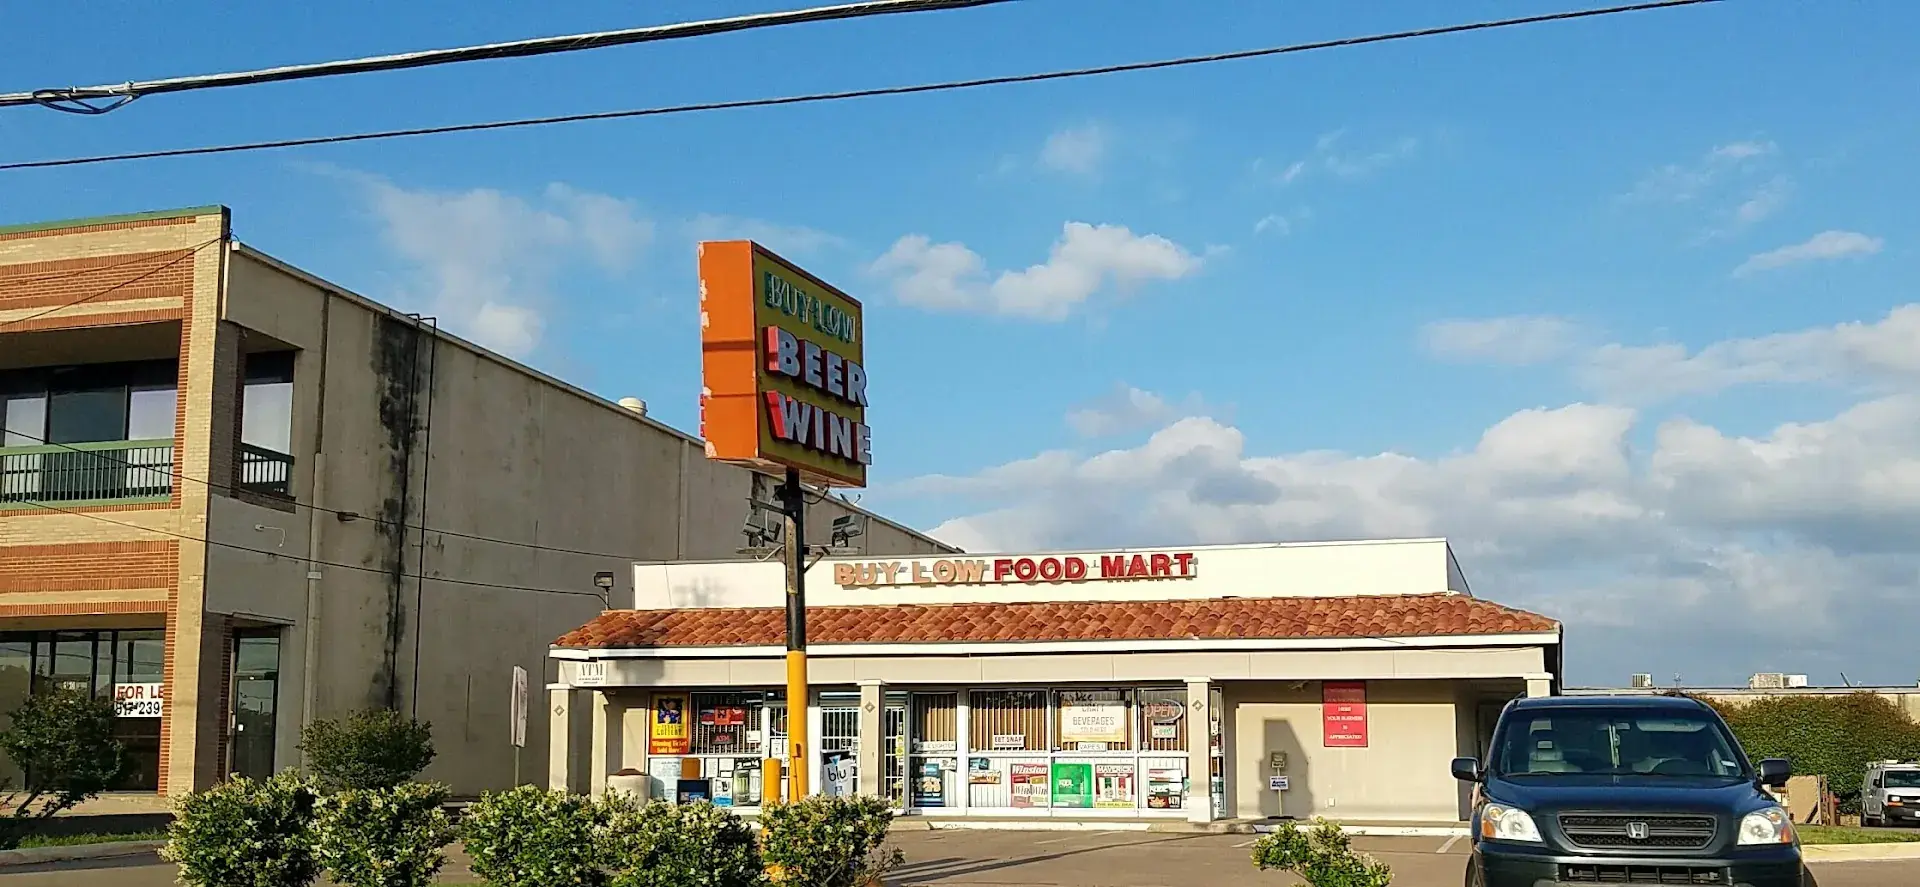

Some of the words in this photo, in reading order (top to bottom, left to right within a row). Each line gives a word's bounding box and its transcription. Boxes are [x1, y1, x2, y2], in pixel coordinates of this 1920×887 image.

[765, 271, 812, 323] BUY
[813, 297, 857, 342] LOW
[768, 325, 868, 407] BEER
[766, 391, 872, 465] WINE
[833, 562, 900, 586] BUY
[911, 559, 985, 584] LOW
[994, 557, 1087, 582] FOOD
[1100, 552, 1194, 579] MART
[117, 685, 144, 700] FOR
[1145, 703, 1176, 718] OPEN
[1072, 716, 1115, 726] BEVERAGES
[827, 765, 847, 782] blu
[1011, 764, 1047, 775] Winston
